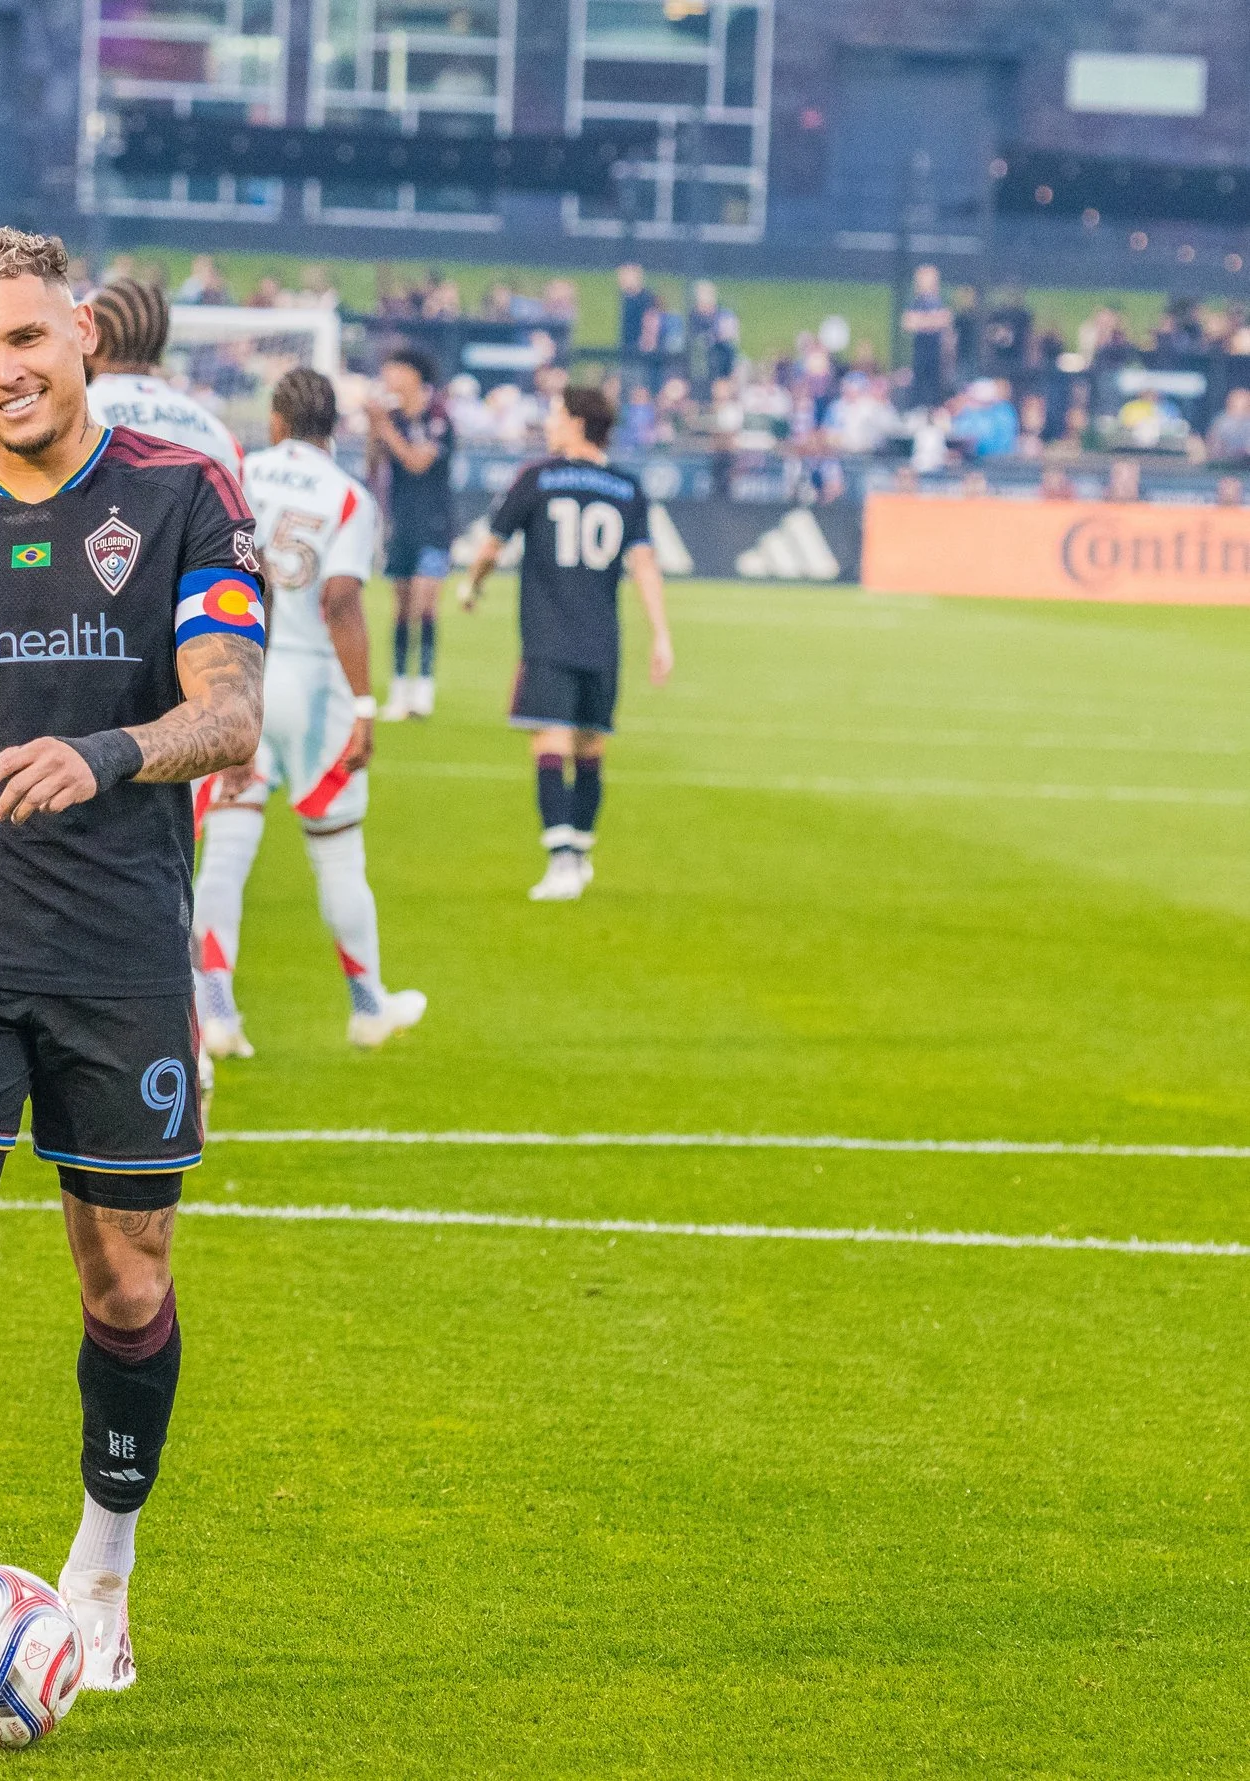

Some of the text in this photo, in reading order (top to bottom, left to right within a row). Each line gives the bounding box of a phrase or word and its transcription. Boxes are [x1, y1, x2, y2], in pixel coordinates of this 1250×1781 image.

[95, 536, 132, 550] COLORADO
[547, 498, 624, 571] 10
[141, 1057, 186, 1140] 9
